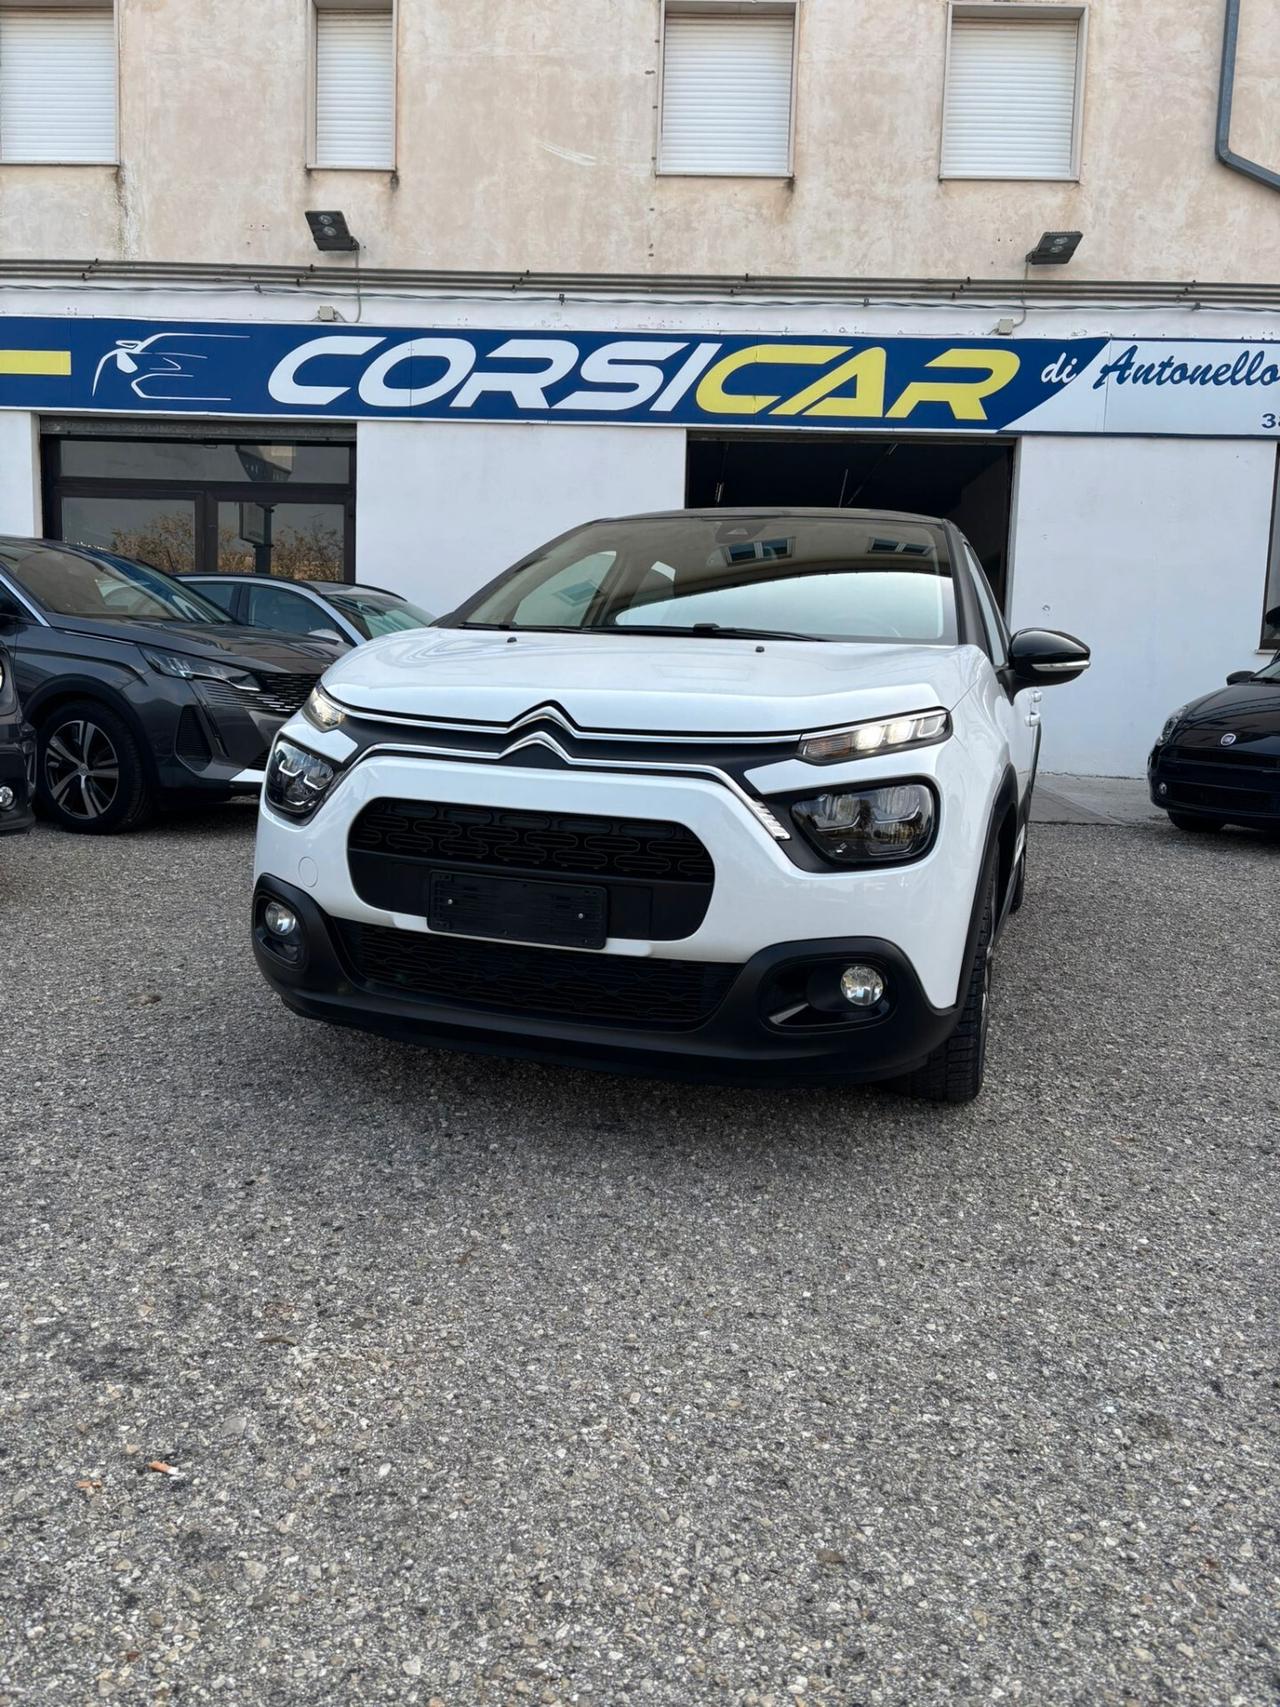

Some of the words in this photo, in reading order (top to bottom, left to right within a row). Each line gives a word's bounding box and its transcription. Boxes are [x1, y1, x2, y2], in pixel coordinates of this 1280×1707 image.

[268, 335, 1020, 420] CORSICAR
[1040, 352, 1079, 384] di
[1092, 344, 1280, 390] Antonello
[1261, 413, 1280, 429] 3
